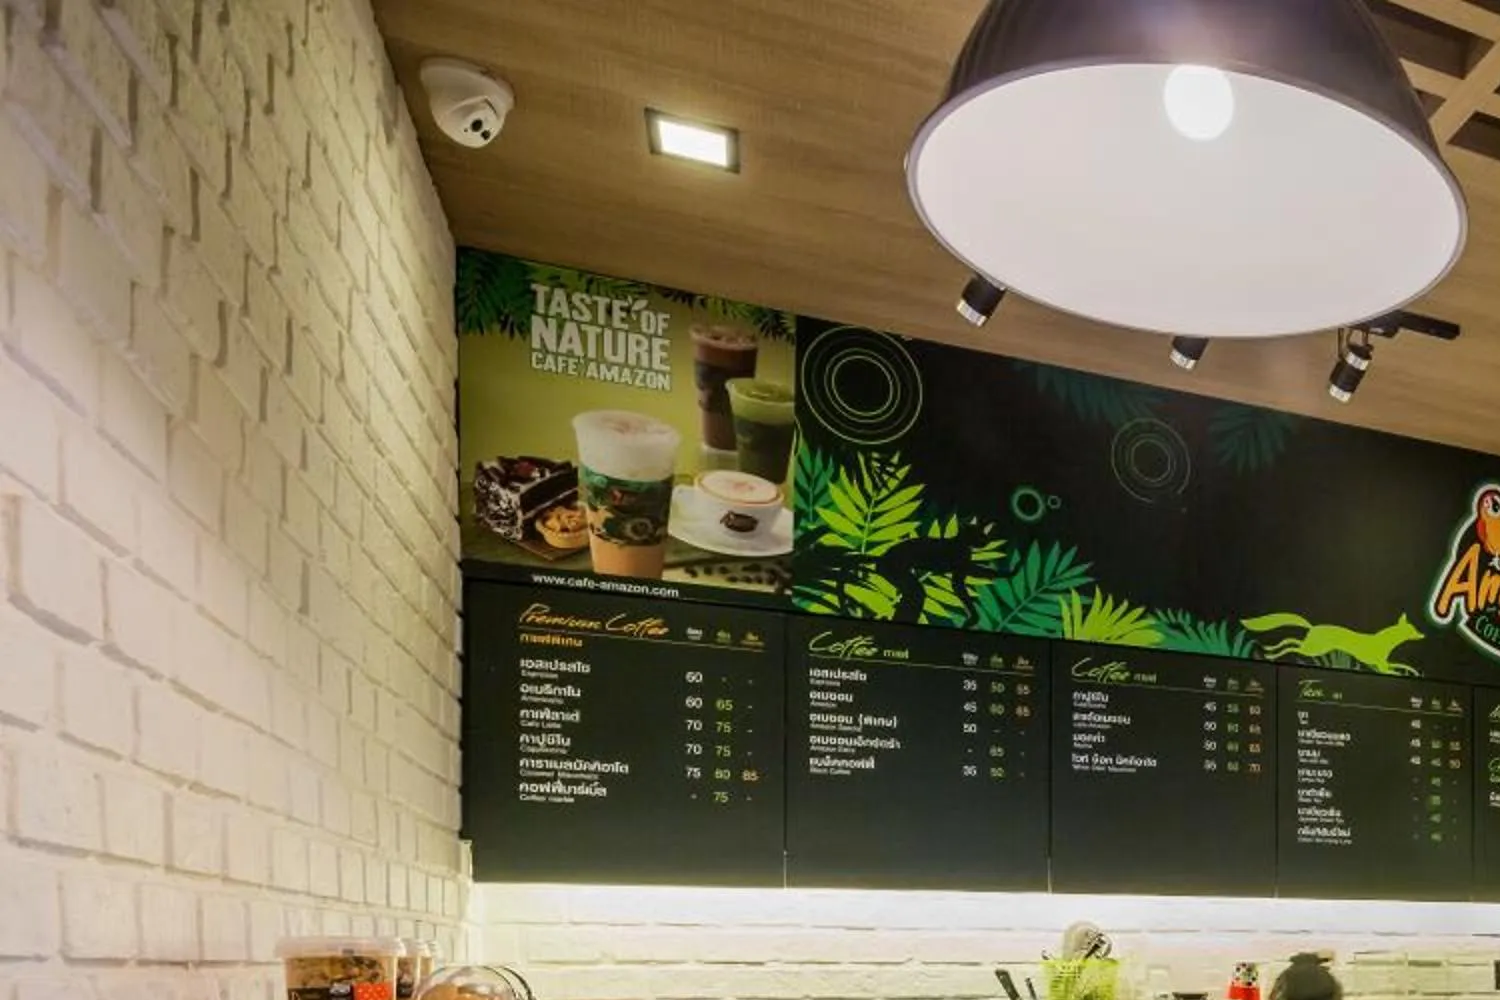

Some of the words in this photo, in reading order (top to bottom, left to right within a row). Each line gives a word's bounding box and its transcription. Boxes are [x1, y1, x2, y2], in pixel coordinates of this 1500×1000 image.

[531, 283, 634, 328] TASTE
[640, 309, 671, 336] OF
[531, 315, 671, 371] NATURE
[587, 359, 672, 391] AMAZON
[531, 572, 680, 598] www.cafe-amazon.com
[604, 613, 671, 638] Coffee
[808, 631, 879, 659] Coffee
[685, 671, 704, 684] 60
[1072, 657, 1131, 684] Coffee
[685, 696, 703, 709] 60
[685, 719, 703, 731] 70
[685, 743, 703, 756] 70
[686, 767, 702, 779] 75
